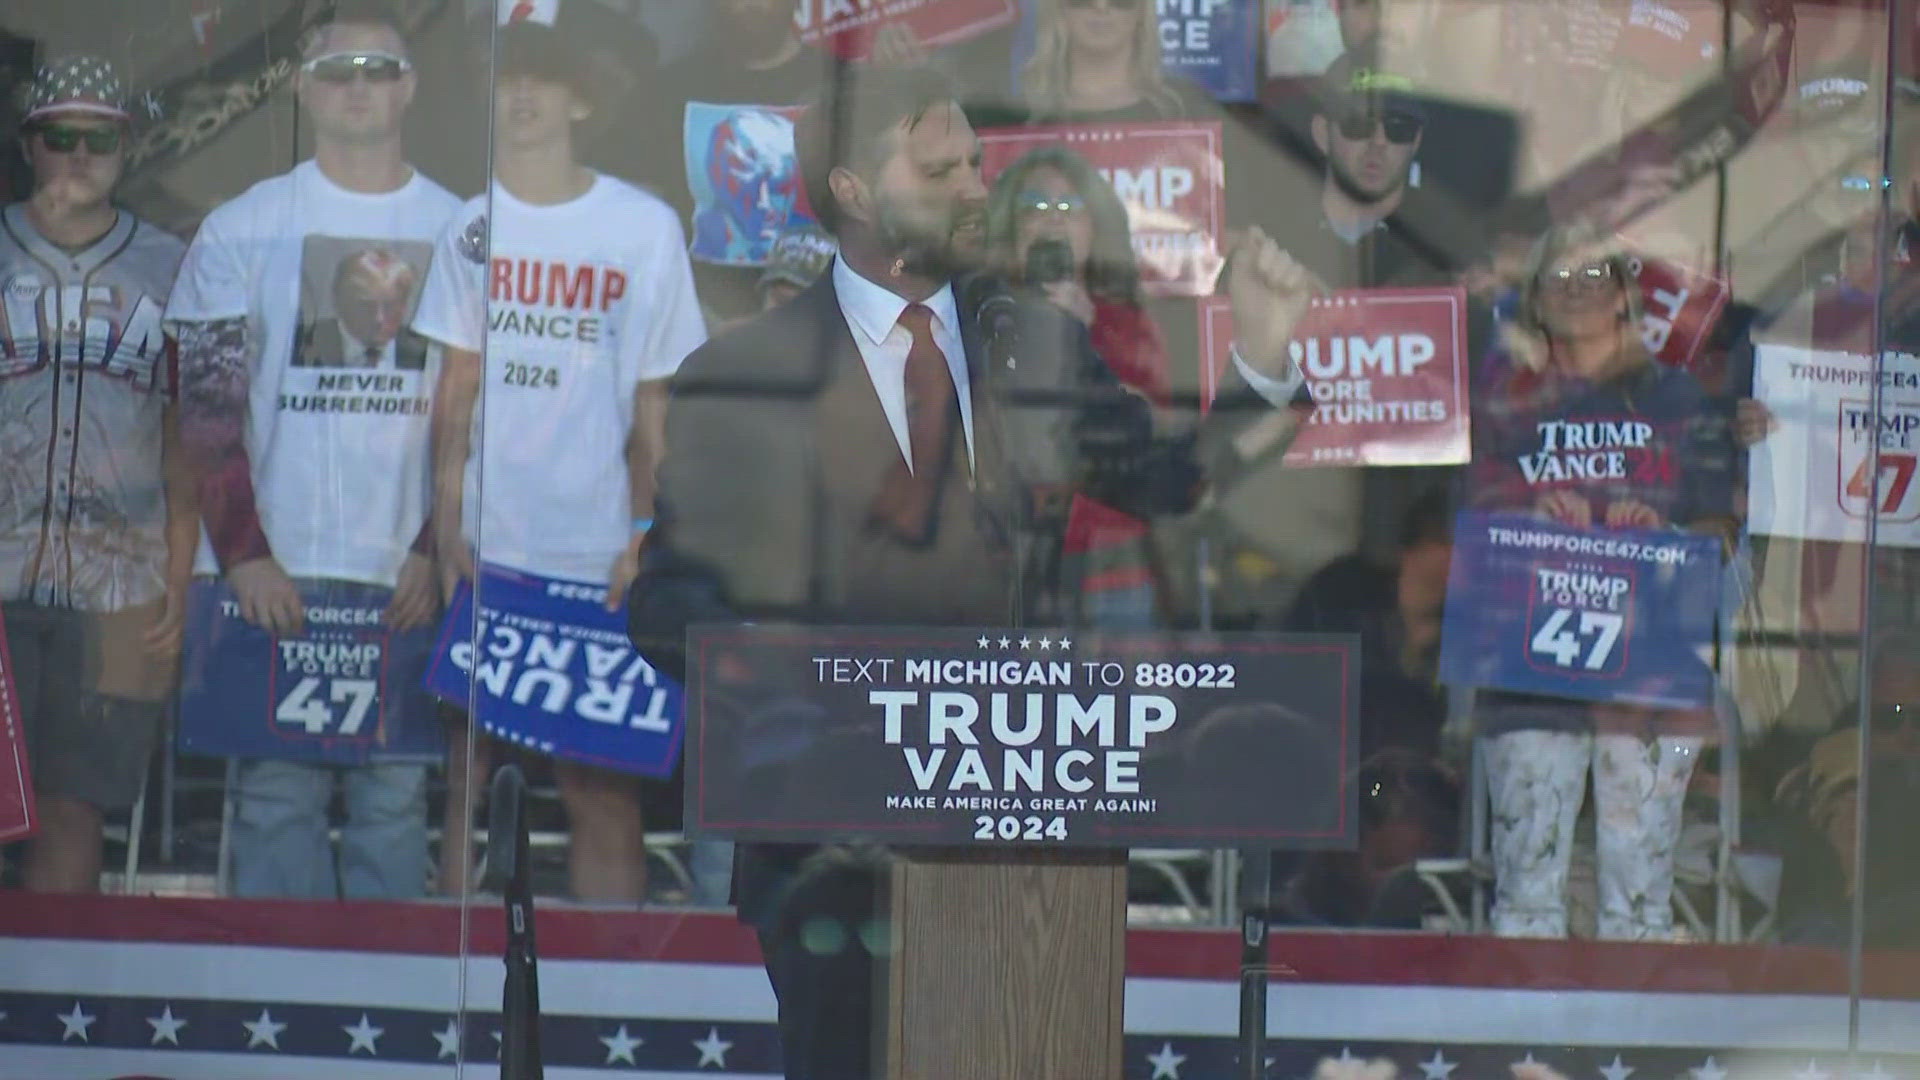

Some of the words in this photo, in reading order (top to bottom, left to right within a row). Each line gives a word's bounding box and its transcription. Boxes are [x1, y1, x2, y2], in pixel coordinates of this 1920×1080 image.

[489, 258, 627, 313] RUMP
[1290, 333, 1436, 380] UMP
[318, 373, 404, 392] NEVER
[503, 361, 559, 389] 2024
[1305, 379, 1373, 402] ORE
[1536, 419, 1653, 452] TRUMP
[1518, 450, 1626, 486] VANCE
[1488, 526, 1687, 566] TRUMPFORCE47.COM
[1536, 567, 1630, 598] TRUMP
[1542, 588, 1618, 611] FORCE
[278, 640, 380, 665] TRUMP
[1530, 607, 1624, 671] 47
[449, 641, 671, 733] TRUMP
[812, 658, 895, 684] TEXT
[905, 659, 1071, 686] MICHIGAN
[1082, 662, 1125, 687] TO
[1134, 663, 1236, 689] 88022
[275, 676, 378, 735] 47
[868, 690, 1178, 748] TRUMP
[903, 747, 1140, 793] VANCE
[886, 795, 937, 809] MAKE
[943, 797, 1024, 811] AMERICA
[1030, 798, 1088, 811] GREAT
[1094, 799, 1157, 813] AGAIN!
[973, 814, 1069, 841] 2024
